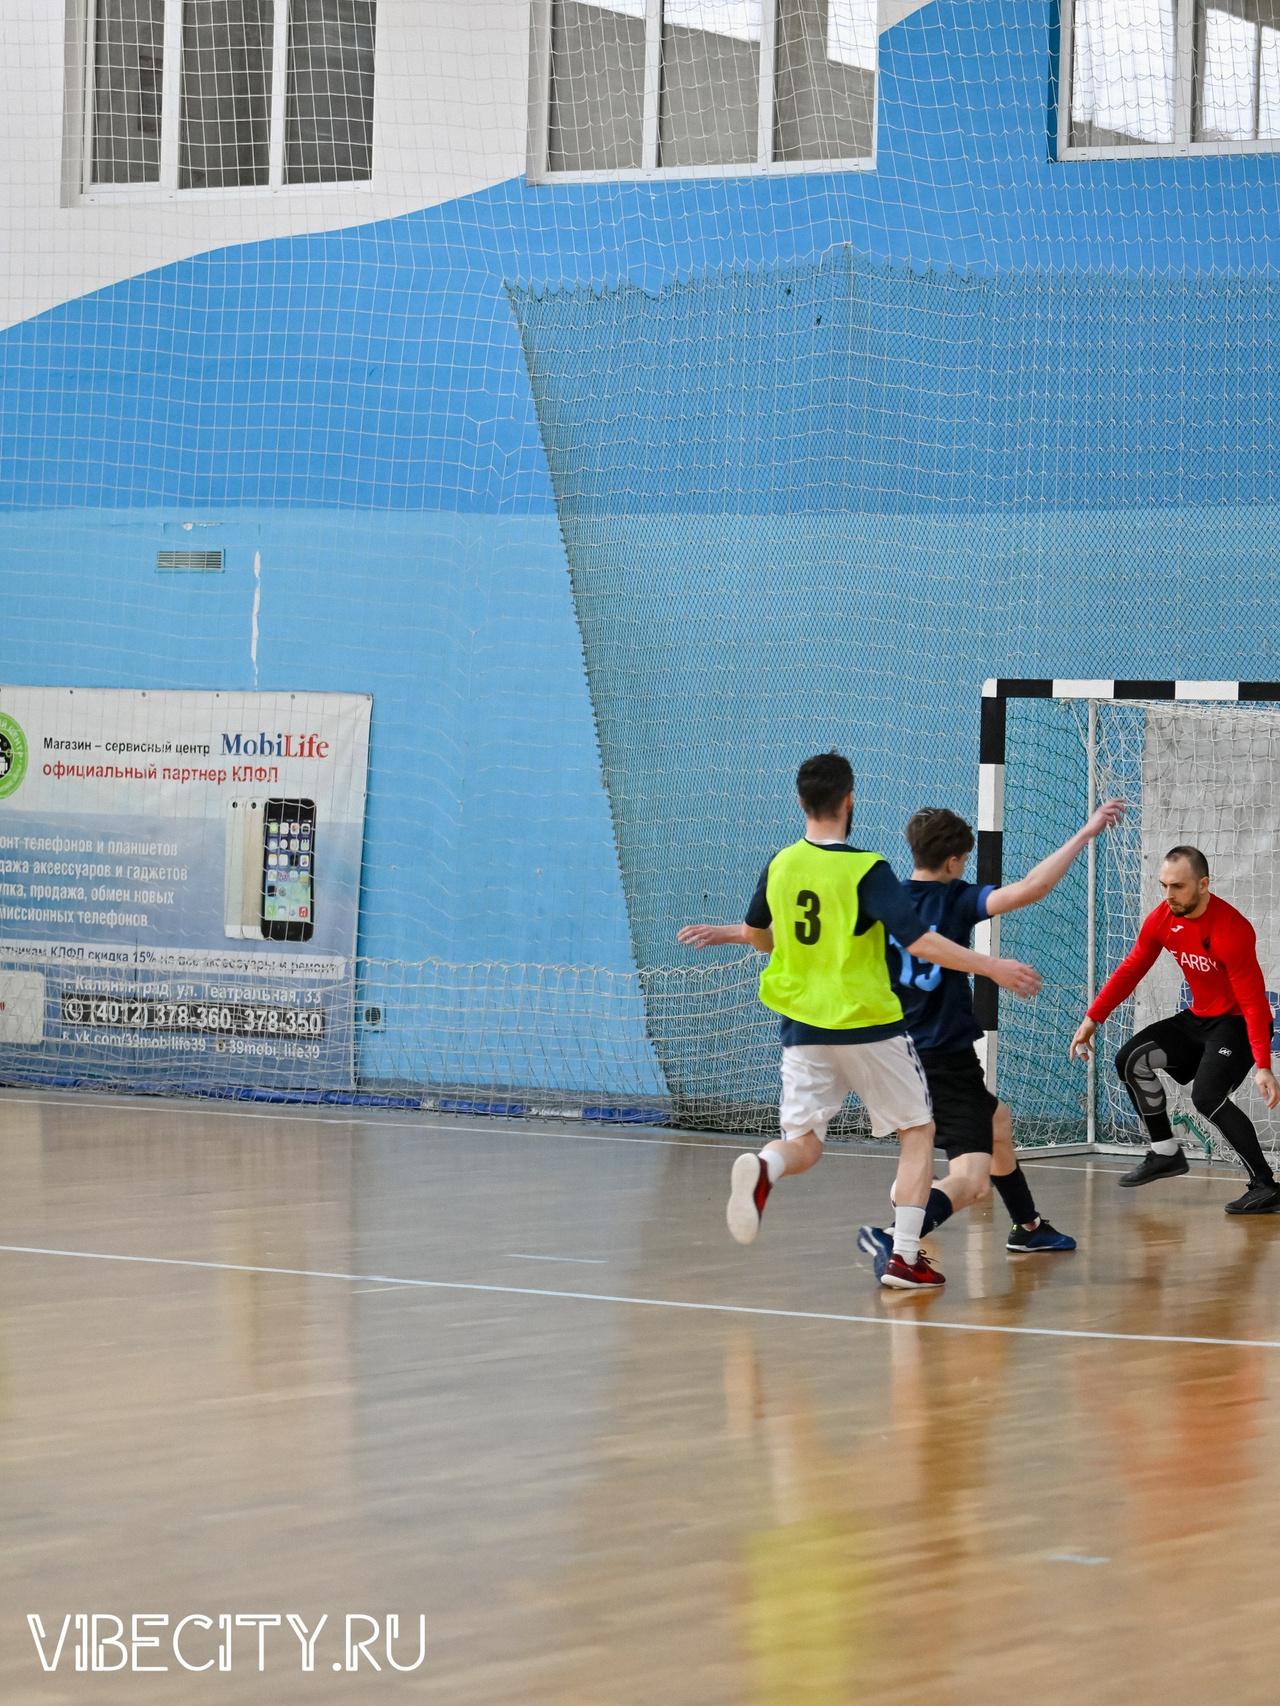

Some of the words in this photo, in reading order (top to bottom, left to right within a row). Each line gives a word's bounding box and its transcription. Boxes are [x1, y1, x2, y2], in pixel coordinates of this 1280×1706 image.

[43, 737, 92, 751] Магазин
[105, 740, 172, 755] сервисный
[175, 743, 210, 757] центр
[220, 731, 330, 758] MobiLife
[42, 760, 158, 780] официальный
[162, 766, 227, 785] партнер
[232, 765, 278, 783] КЛФЛ
[24, 835, 93, 855] телефонов
[97, 840, 105, 853] и
[108, 841, 179, 857] планшетов
[33, 861, 112, 882] аксессуаров
[115, 865, 123, 878] и
[127, 866, 188, 882] гаджетов
[30, 885, 88, 902] продажа,
[91, 885, 131, 903] обмен
[134, 890, 174, 905] новых
[78, 908, 148, 928] телефонов
[795, 889, 821, 946] 3
[50, 946, 85, 960] КЛФЛ
[88, 950, 129, 963] скидка
[132, 950, 157, 964] 15%
[176, 984, 198, 1000] ул.
[202, 982, 301, 1004] Театральная,
[304, 990, 322, 1004] 33
[90, 999, 149, 1030] (4012)
[243, 1010, 323, 1035] 378-350
